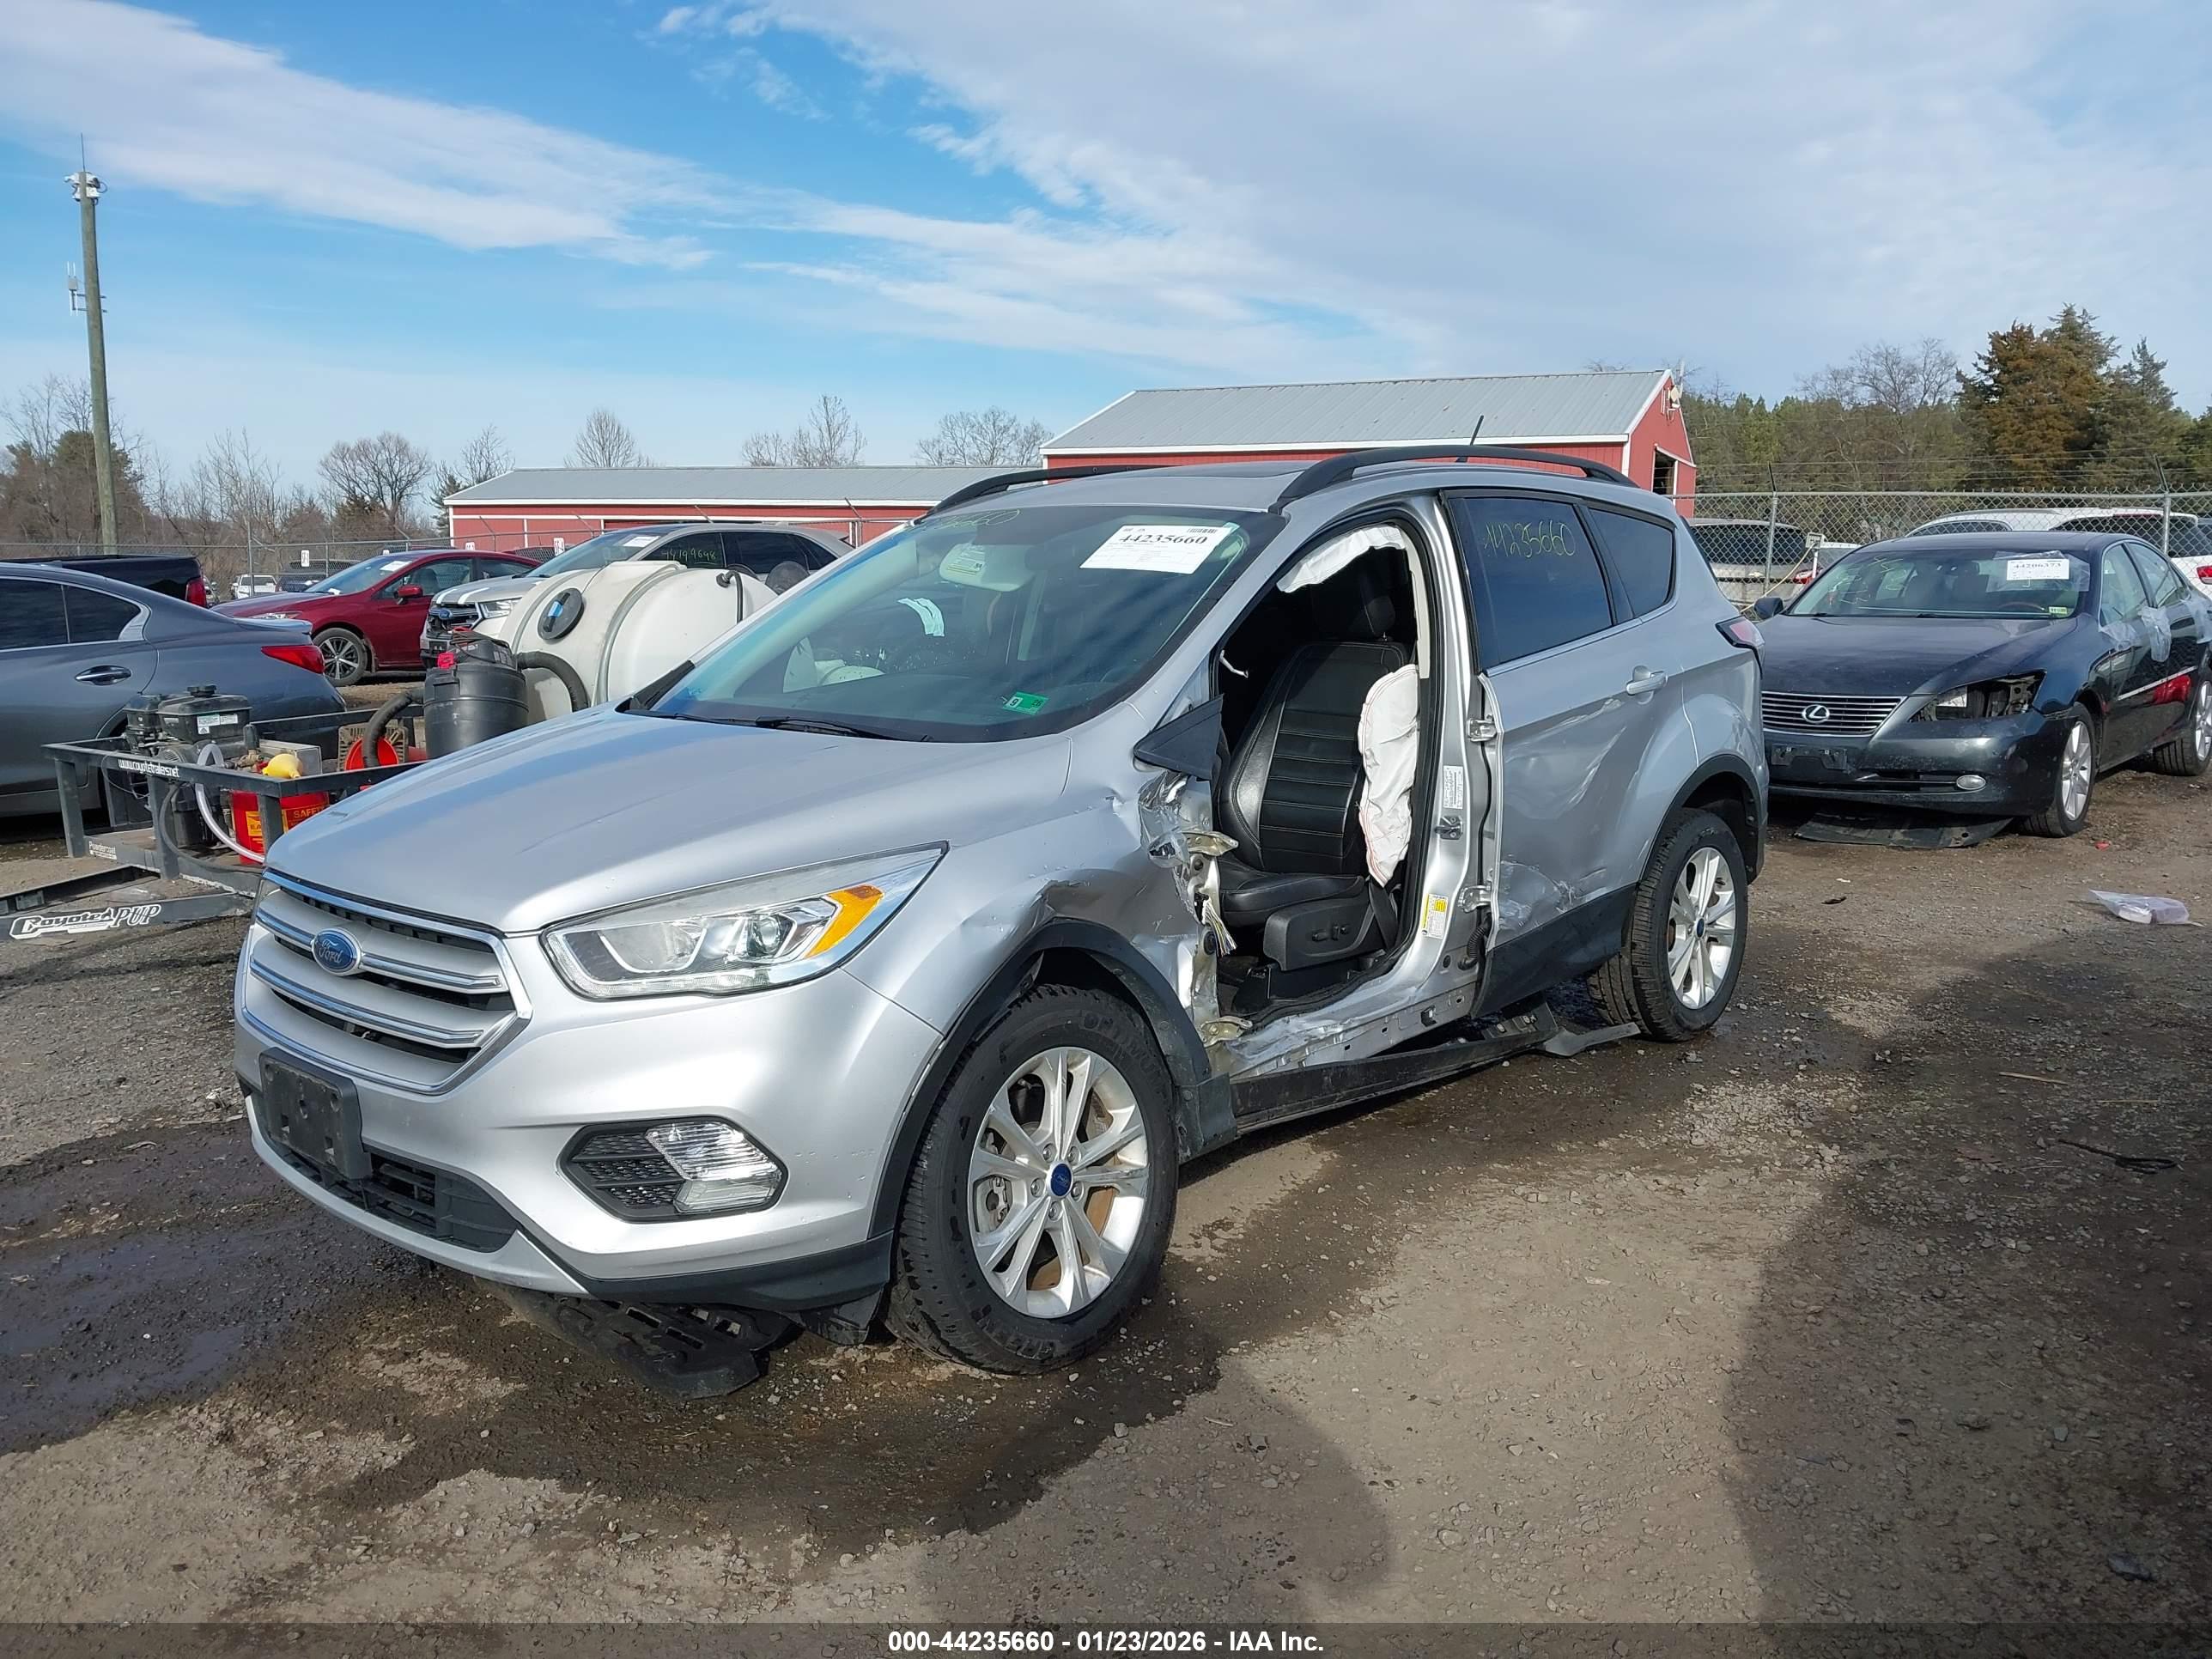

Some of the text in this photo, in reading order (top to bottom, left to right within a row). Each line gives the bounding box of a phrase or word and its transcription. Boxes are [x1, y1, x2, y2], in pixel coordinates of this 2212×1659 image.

[1119, 534, 1208, 544] 44235660
[1009, 698, 1019, 707] 9
[112, 904, 161, 928] PUP
[319, 939, 343, 963] Ford
